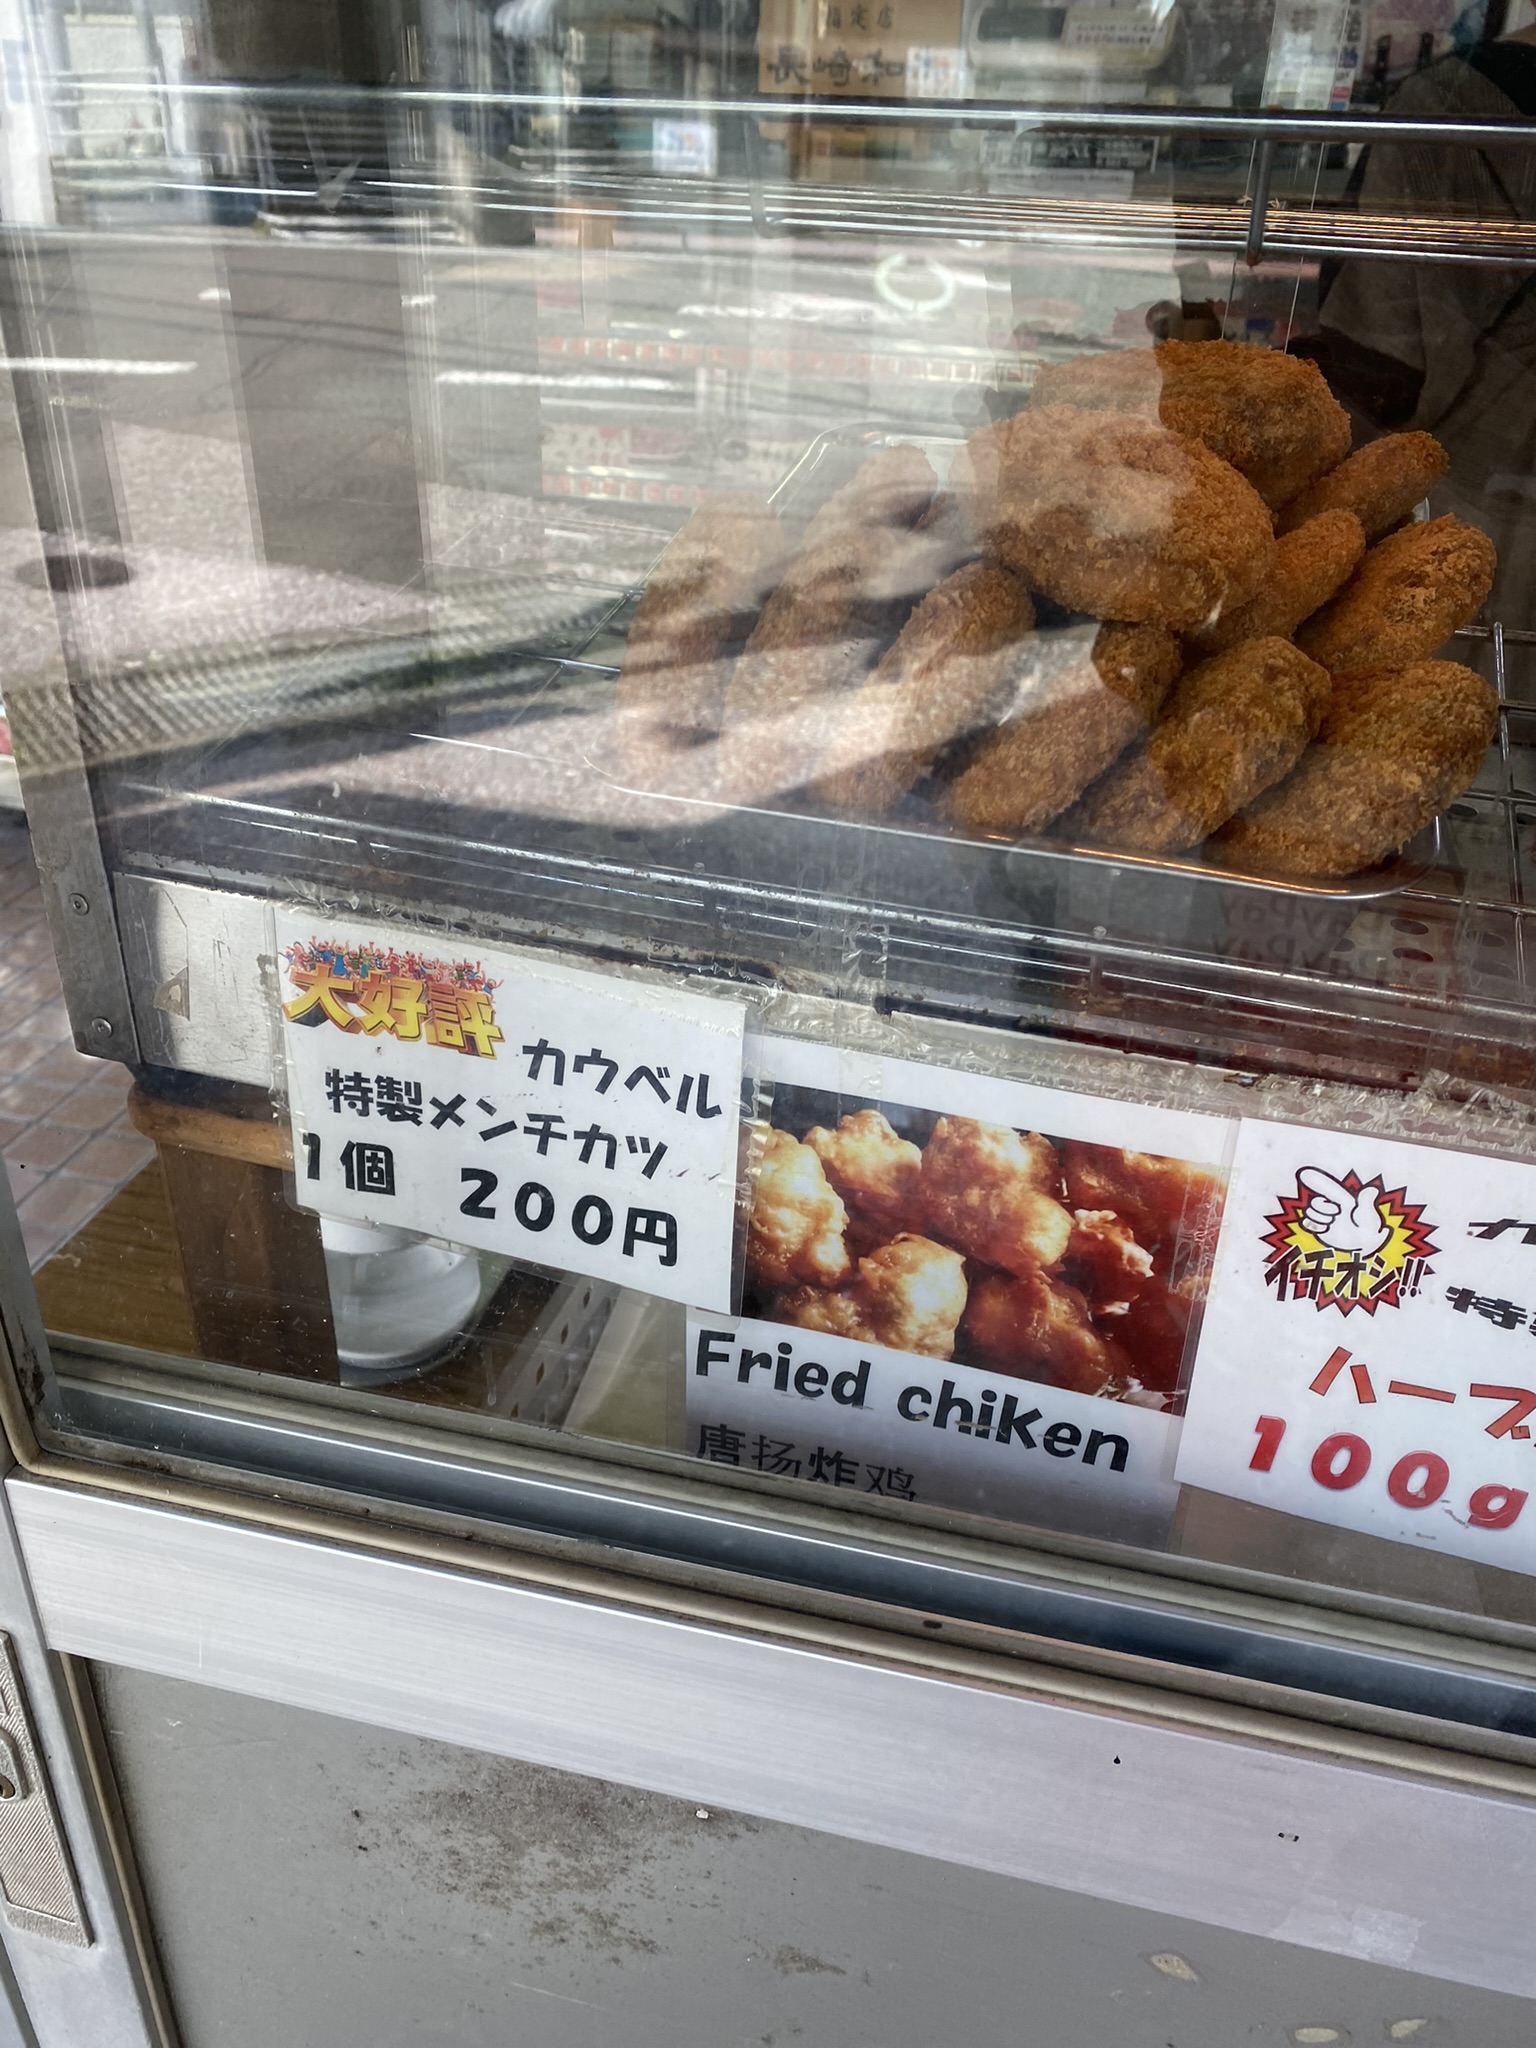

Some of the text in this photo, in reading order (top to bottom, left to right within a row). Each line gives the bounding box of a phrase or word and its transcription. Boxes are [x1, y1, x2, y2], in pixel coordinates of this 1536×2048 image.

[282, 962, 505, 1060] 大好評
[324, 1068, 669, 1180] 特製メンチカツ
[522, 1037, 723, 1119] カウベル
[302, 1131, 678, 1267] 1個 200円
[1444, 1286, 1536, 1337] 特
[695, 1329, 1131, 1473] Fried chiken
[696, 1423, 917, 1502] 唐扬炸鸡
[1249, 1414, 1529, 1530] 100g
